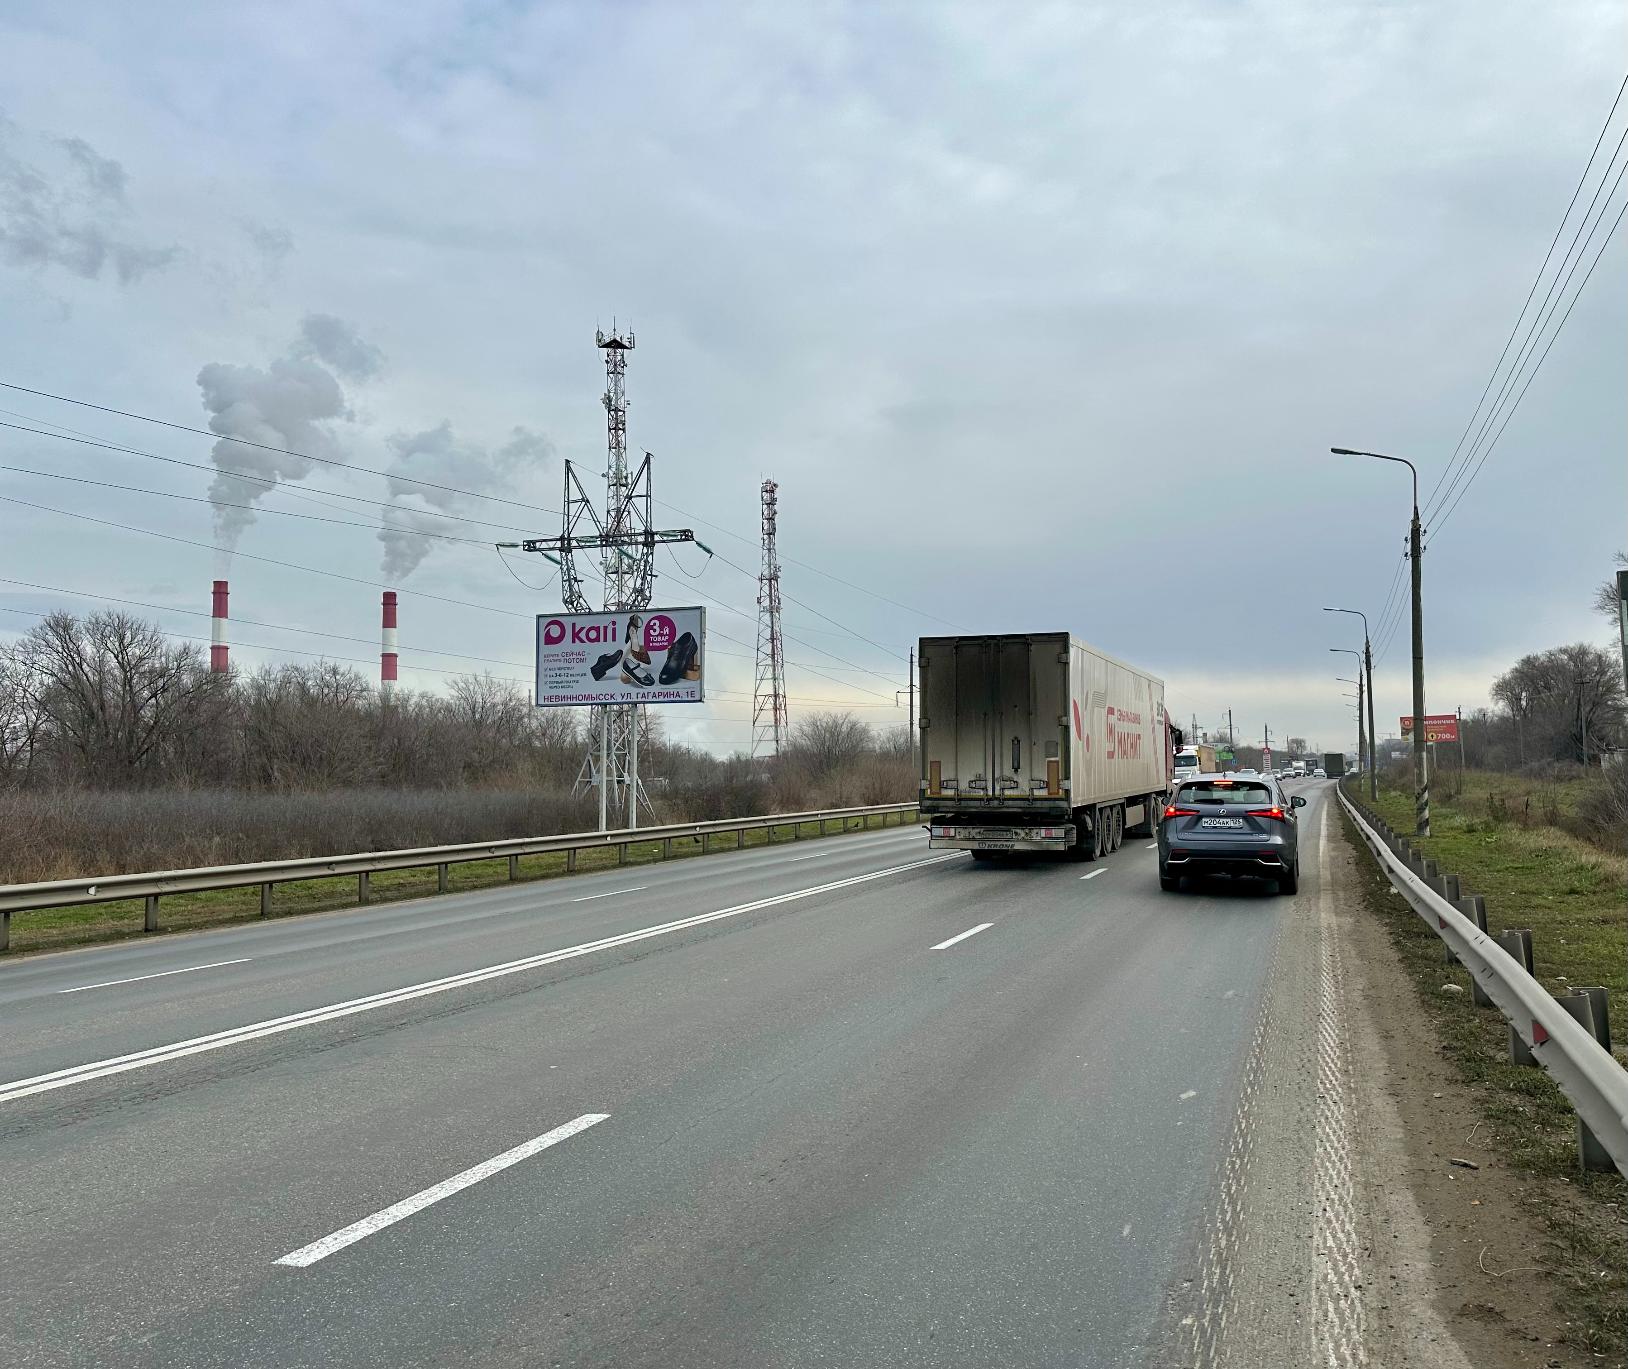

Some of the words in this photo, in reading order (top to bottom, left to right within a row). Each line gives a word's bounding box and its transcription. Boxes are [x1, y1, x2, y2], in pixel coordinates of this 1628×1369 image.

[572, 620, 617, 644] kari
[561, 650, 586, 658] СЕЙЧАС
[543, 693, 618, 703] НЕВИННОМЫССК,
[620, 692, 633, 701] УЛ.
[686, 690, 696, 698] 1Е
[1117, 731, 1141, 760] МАГНИТ
